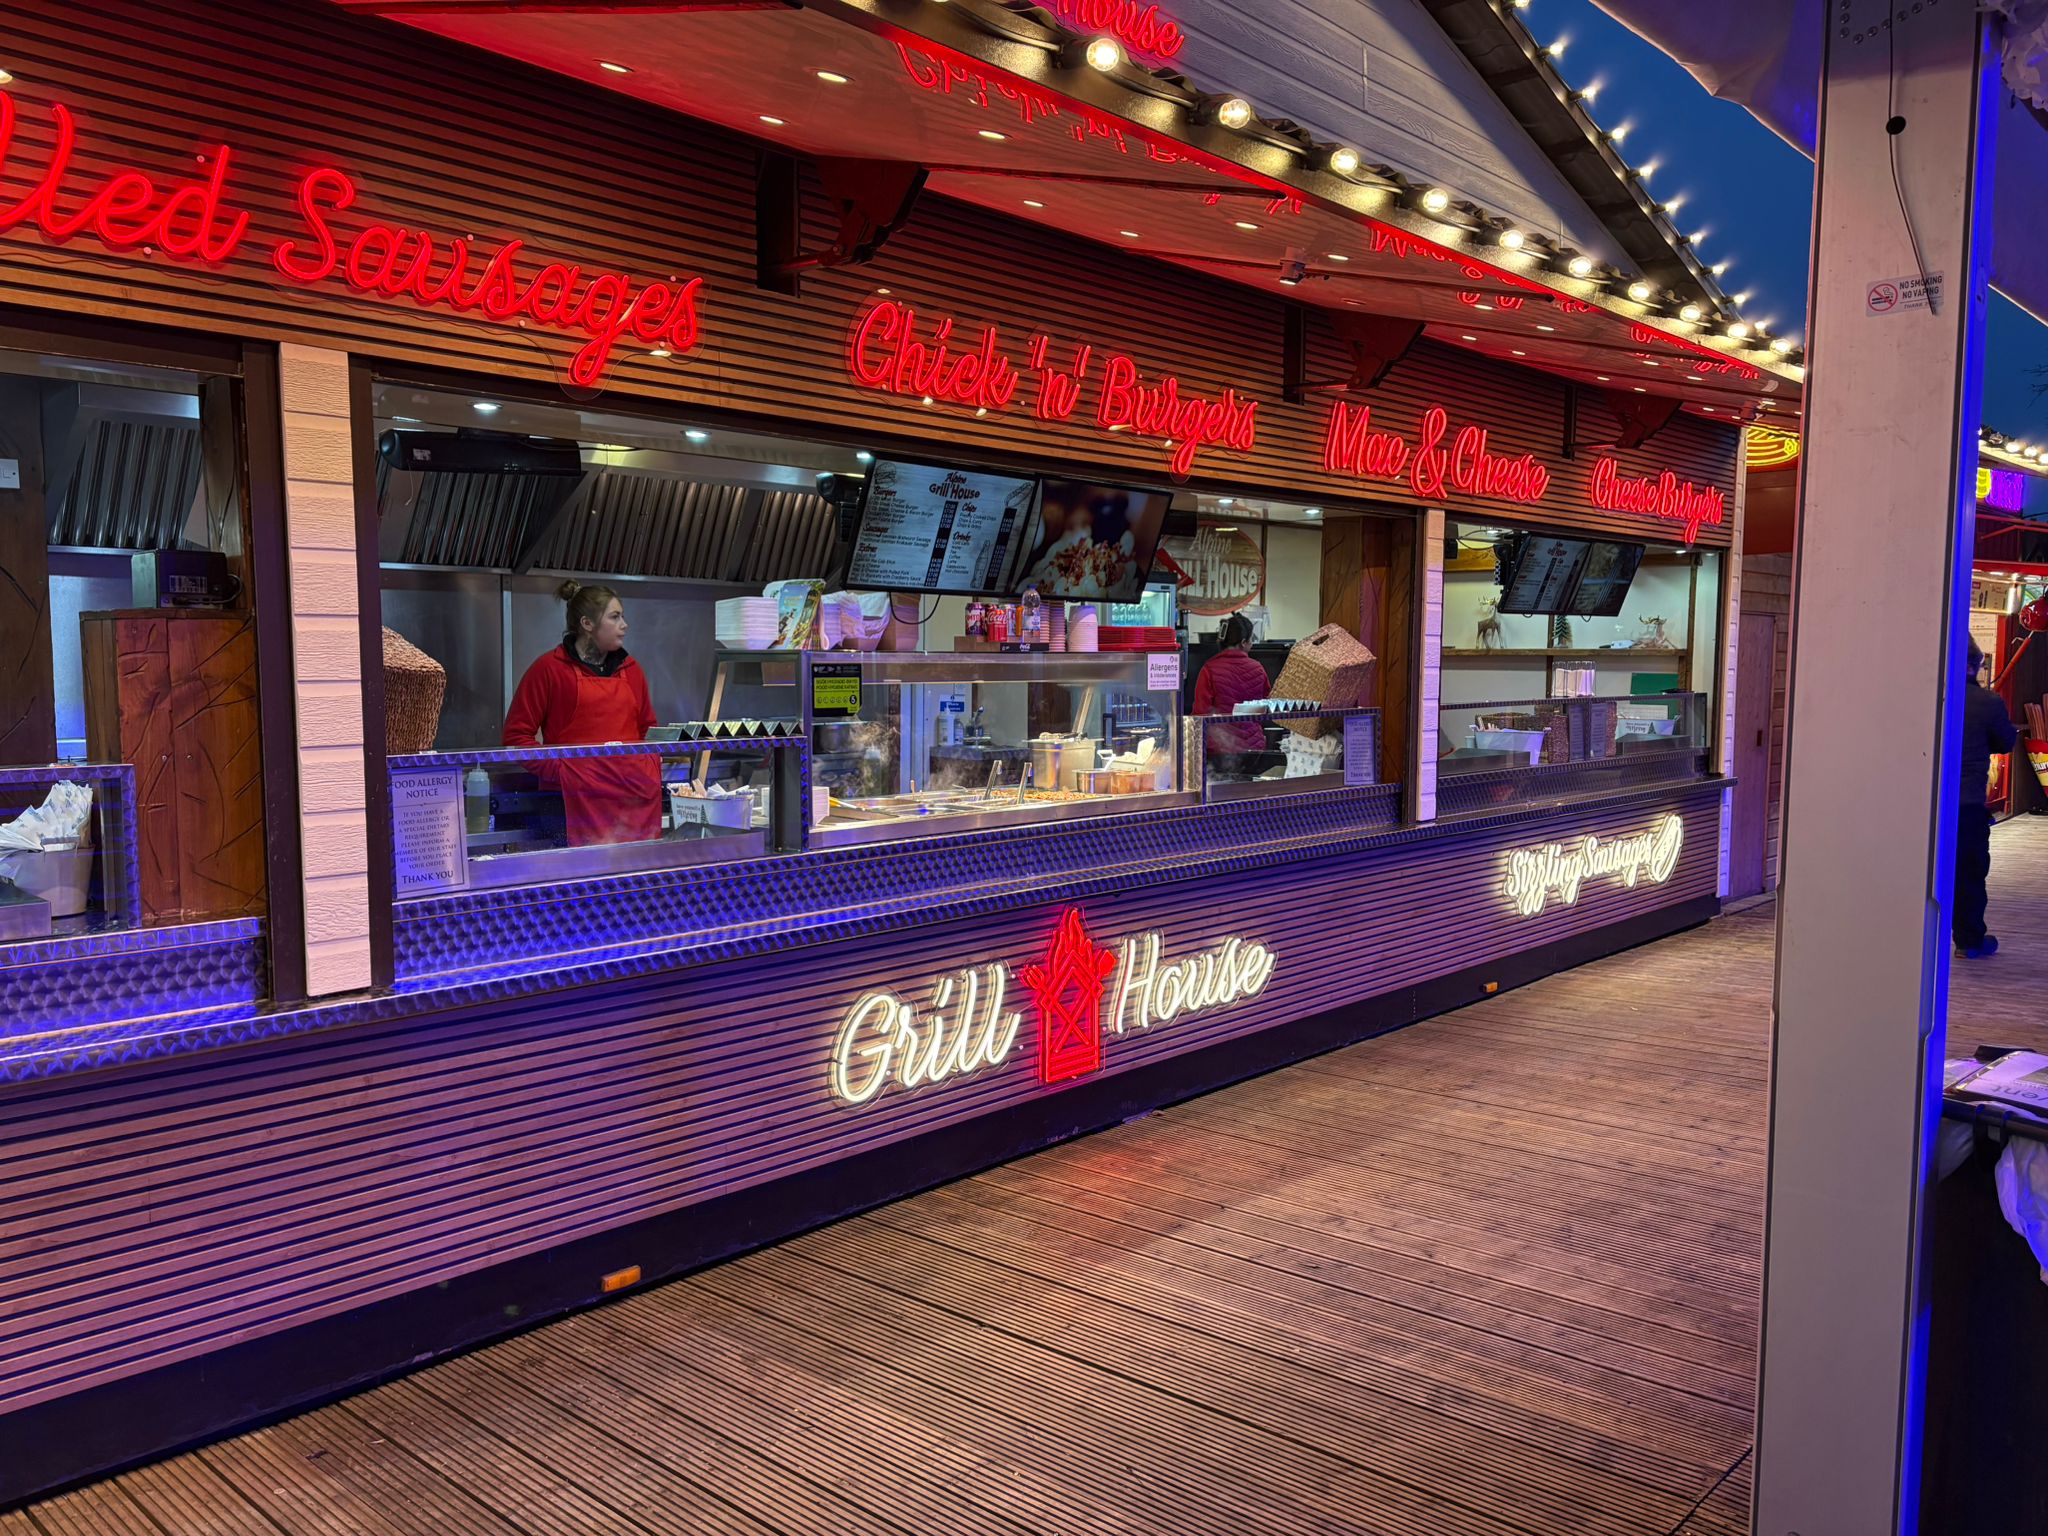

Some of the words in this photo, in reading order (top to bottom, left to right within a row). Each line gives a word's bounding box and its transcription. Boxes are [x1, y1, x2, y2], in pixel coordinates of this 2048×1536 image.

[273, 168, 704, 387] Sausages
[1900, 281, 1909, 289] NO
[1910, 276, 1942, 287] SMOKING
[1902, 291, 1912, 299] NO
[850, 301, 1020, 406] Chick
[1097, 355, 1259, 475] Burgers
[1325, 401, 1409, 476] Mac
[1410, 407, 1447, 498] &
[1450, 426, 1551, 503] Cheese
[945, 472, 967, 484] Alpine
[874, 486, 897, 499] Burgers
[1189, 526, 1232, 566] Alpine
[1208, 554, 1258, 598] House
[1150, 664, 1178, 673] Allergens
[417, 777, 452, 787] ALLERGY
[406, 788, 438, 798] NOTICE
[402, 873, 434, 884] THANK
[435, 870, 454, 880] YOU
[1504, 843, 1582, 916] Sizzling
[1583, 834, 1654, 888] Sausages
[832, 967, 1022, 1103] Grill
[1110, 932, 1275, 1034] House
